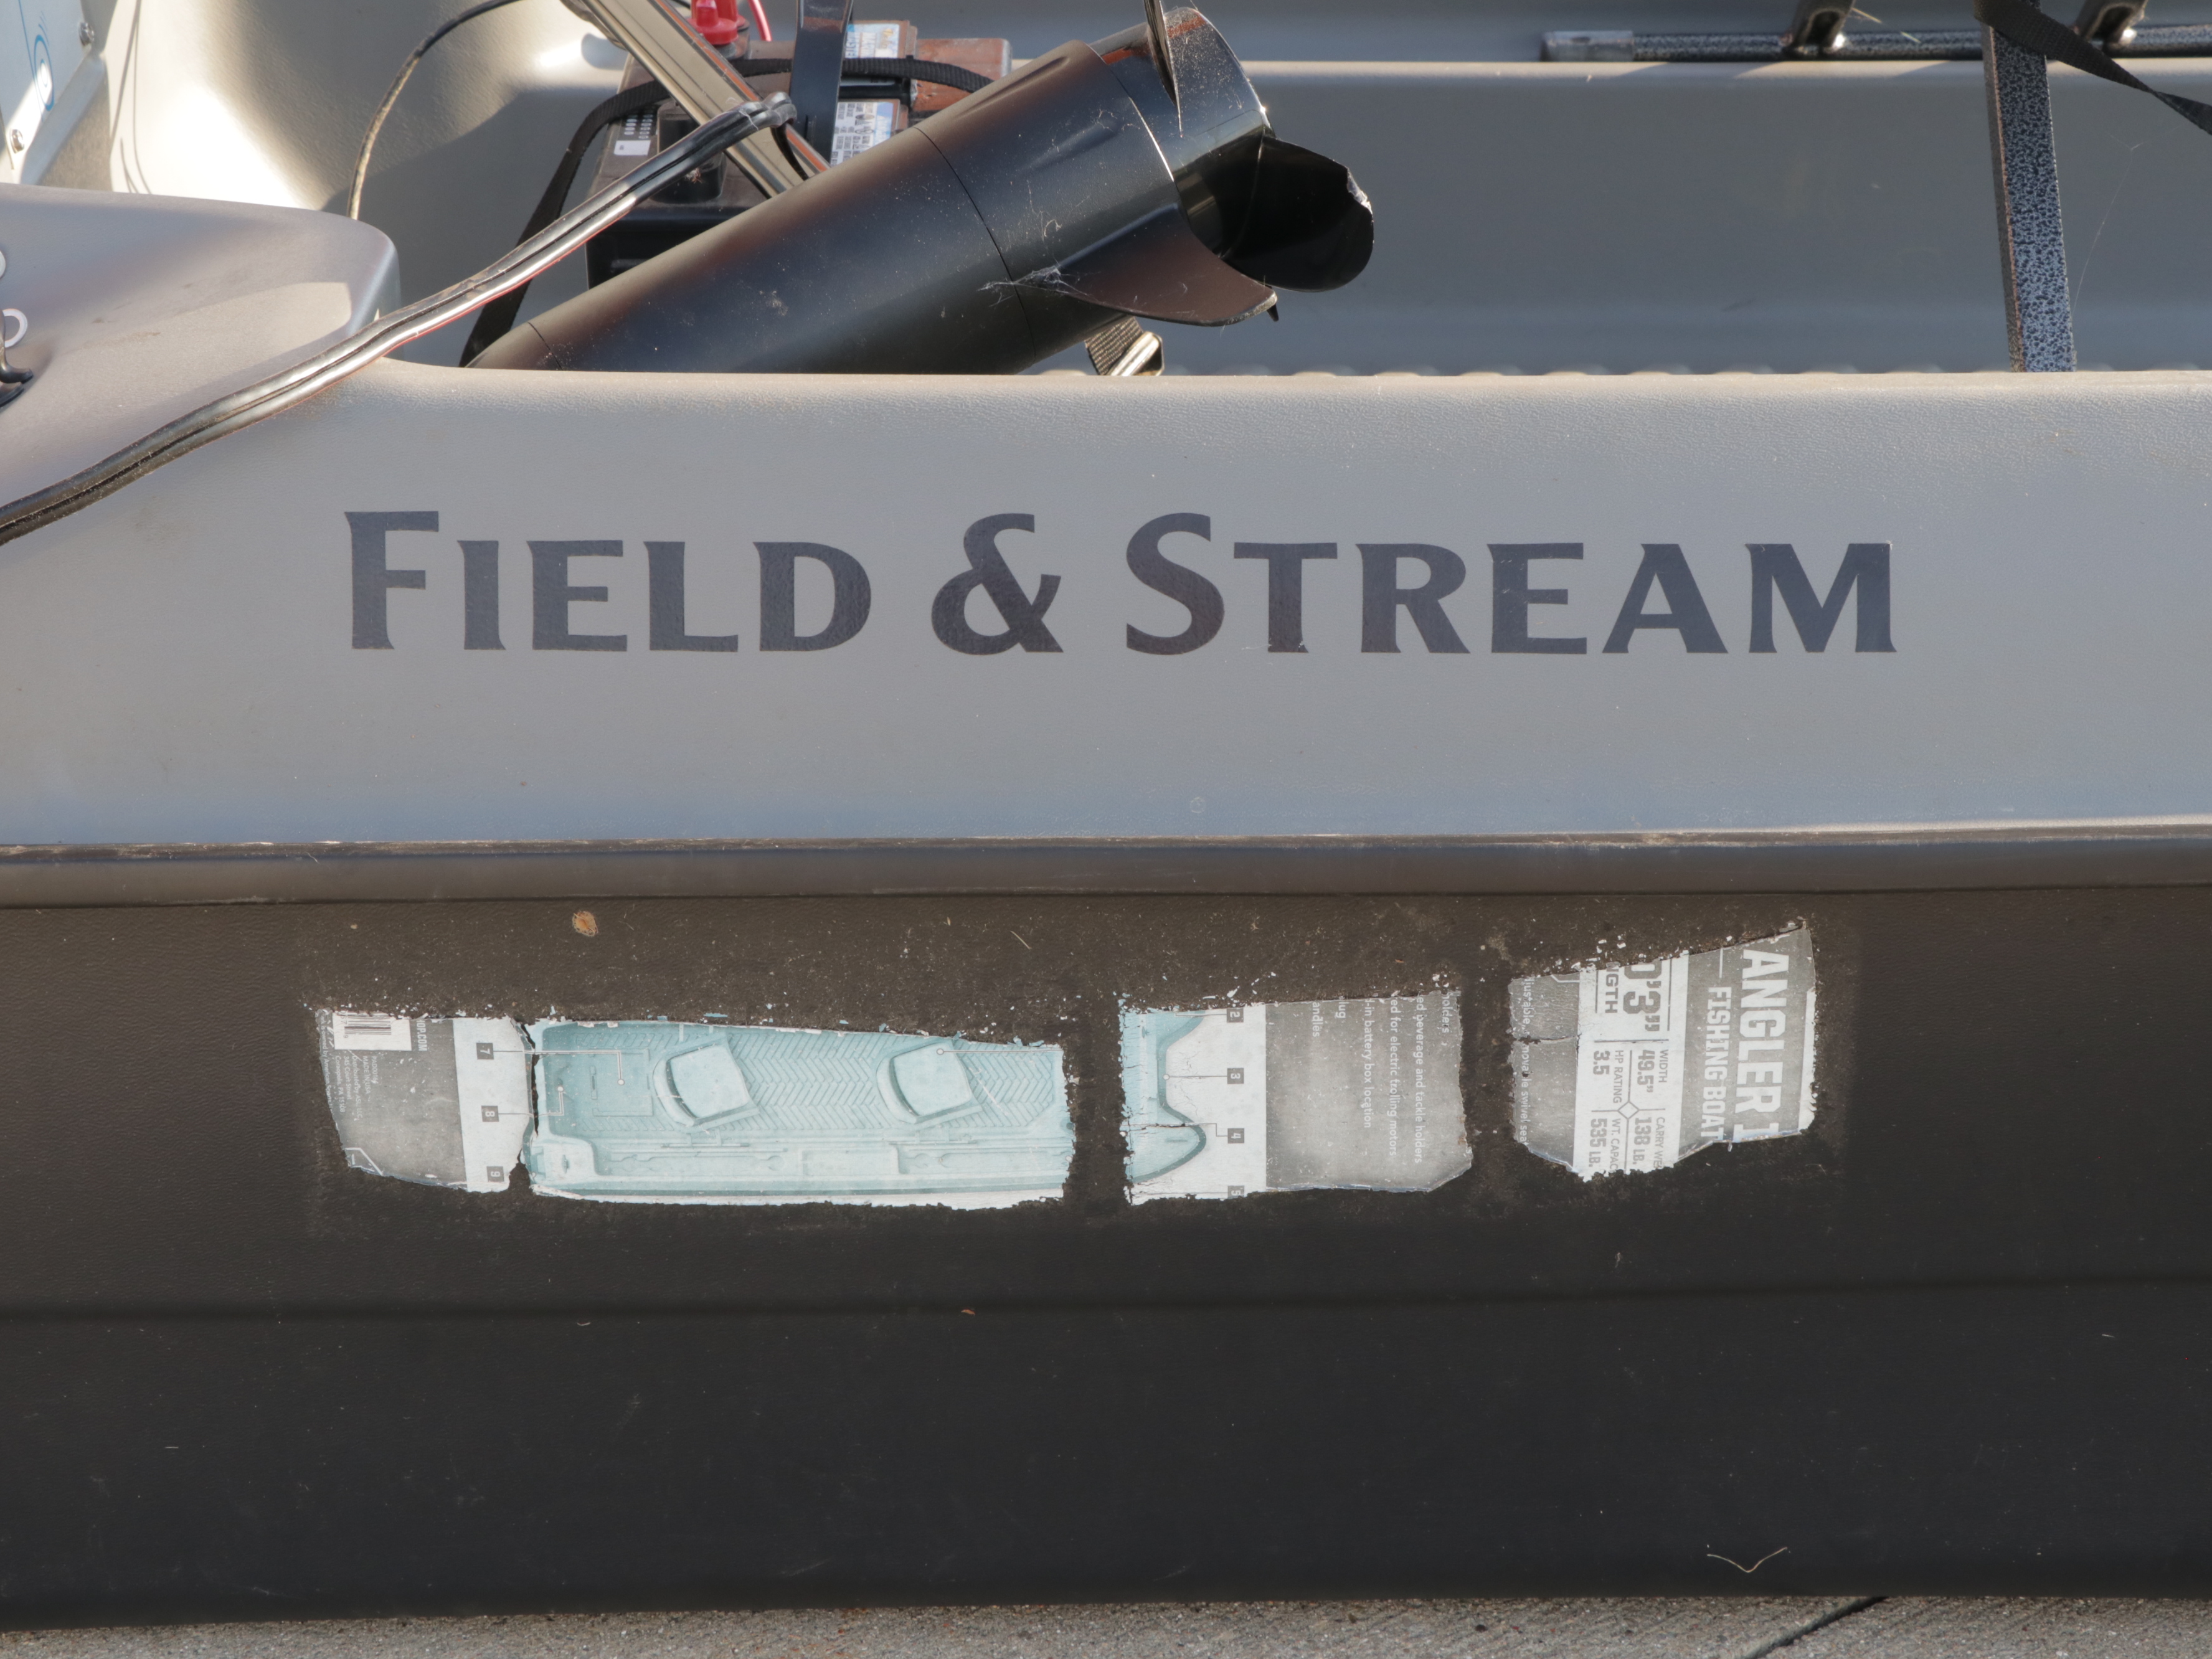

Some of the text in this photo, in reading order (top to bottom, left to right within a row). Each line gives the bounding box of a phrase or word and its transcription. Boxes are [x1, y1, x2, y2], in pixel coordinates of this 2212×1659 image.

[931, 513, 1064, 655] &
[1335, 1001, 1349, 1018] lug
[1390, 1017, 1401, 1033] for
[1362, 1020, 1374, 1059] battery
[1734, 949, 1789, 1113] ANGLER
[324, 1059, 332, 1083] American
[352, 1056, 361, 1085] Distributed
[1364, 1064, 1374, 1083] box
[1390, 1036, 1400, 1075] electric
[1593, 1051, 1610, 1075] 3.5
[1658, 1049, 1669, 1083] WIDTH
[1700, 986, 1732, 1140] FISHING BOAT
[1414, 995, 1427, 1163] ed beverage and tackle holders
[1613, 1050, 1624, 1104] HP RATING
[1364, 1087, 1374, 1128] location
[1387, 1079, 1401, 1117] trolling
[1520, 1091, 1532, 1123] swivel
[1389, 1120, 1399, 1156] motors
[1589, 1118, 1607, 1168] 535 LB.
[1611, 1118, 1620, 1136] WT.
[1633, 1117, 1652, 1165] 138 LB.
[1655, 1117, 1665, 1148] CARRY
